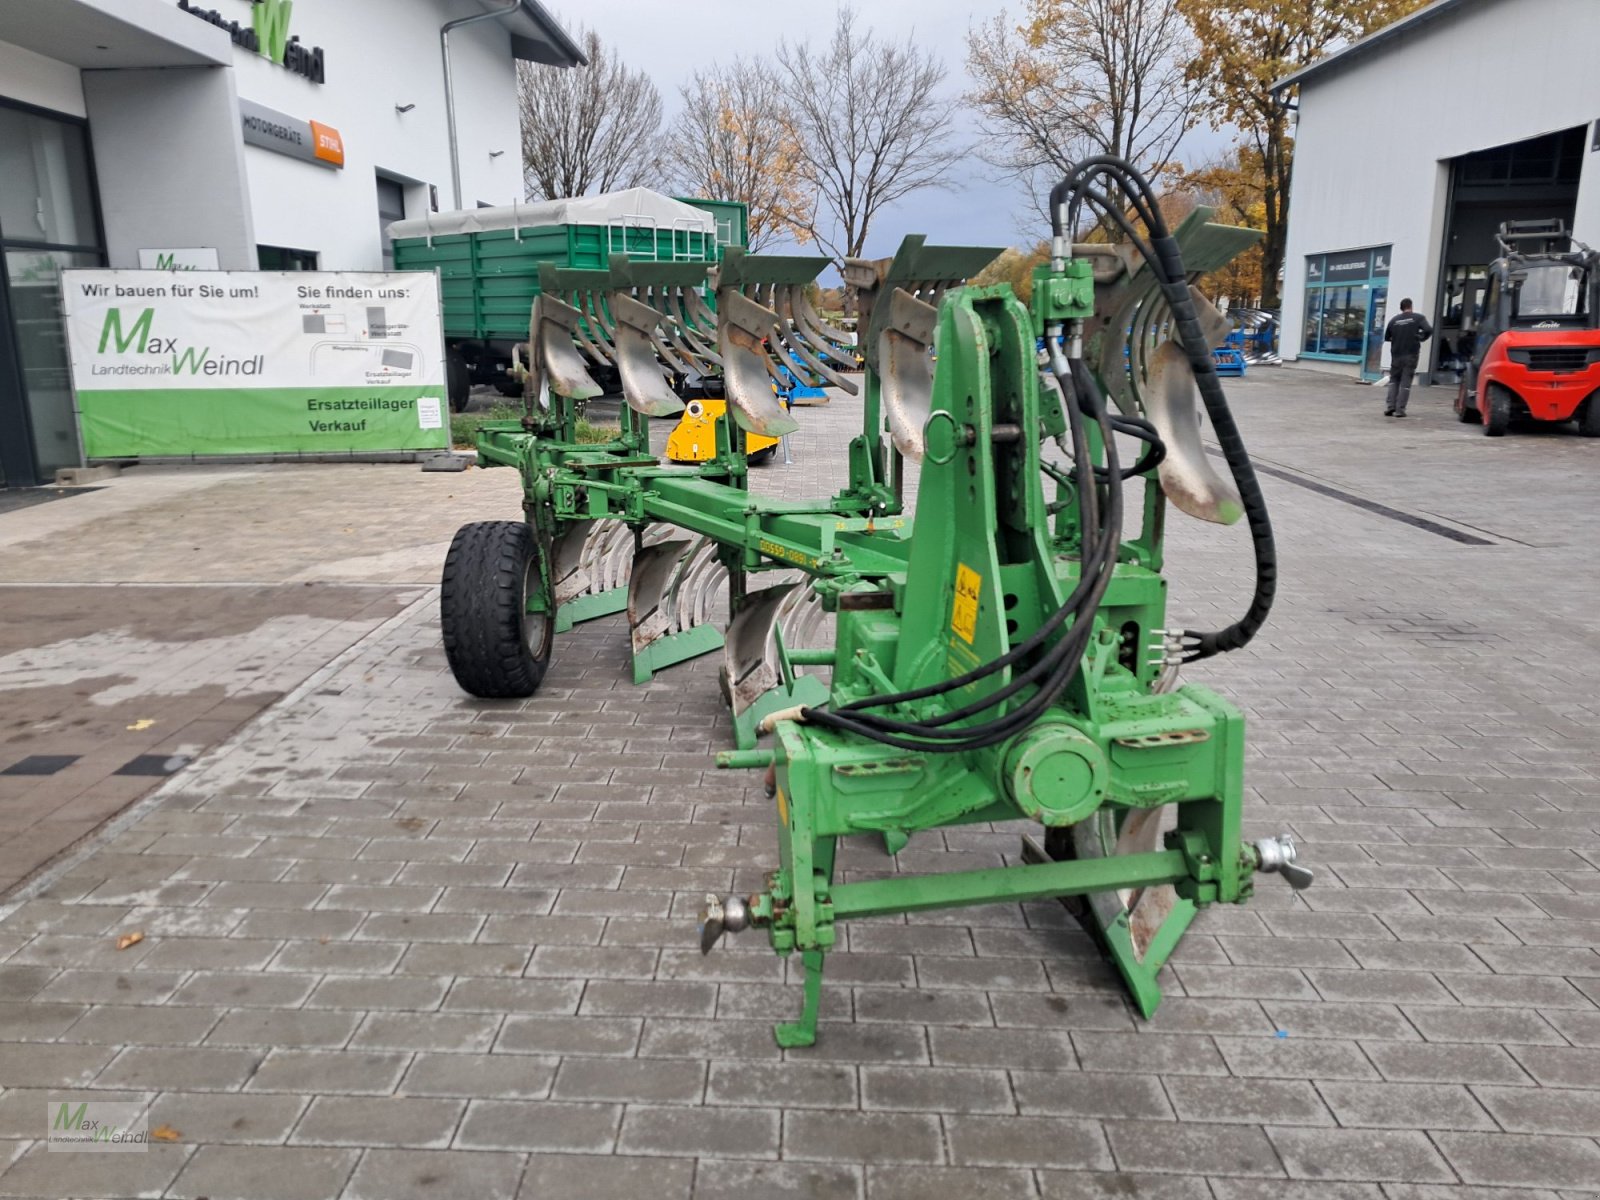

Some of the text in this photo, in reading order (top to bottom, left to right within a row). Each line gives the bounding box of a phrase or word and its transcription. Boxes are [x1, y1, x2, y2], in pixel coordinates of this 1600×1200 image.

[243, 115, 302, 145] MOTORGERÄTE
[81, 283, 259, 298] Wir bauen für Sie um!
[297, 286, 411, 299] Sie finden uns:
[97, 307, 178, 354] Max
[91, 346, 264, 376] Landtechnik Weindl
[307, 398, 415, 412] Ersatzteillager
[309, 419, 367, 432] Verkauf
